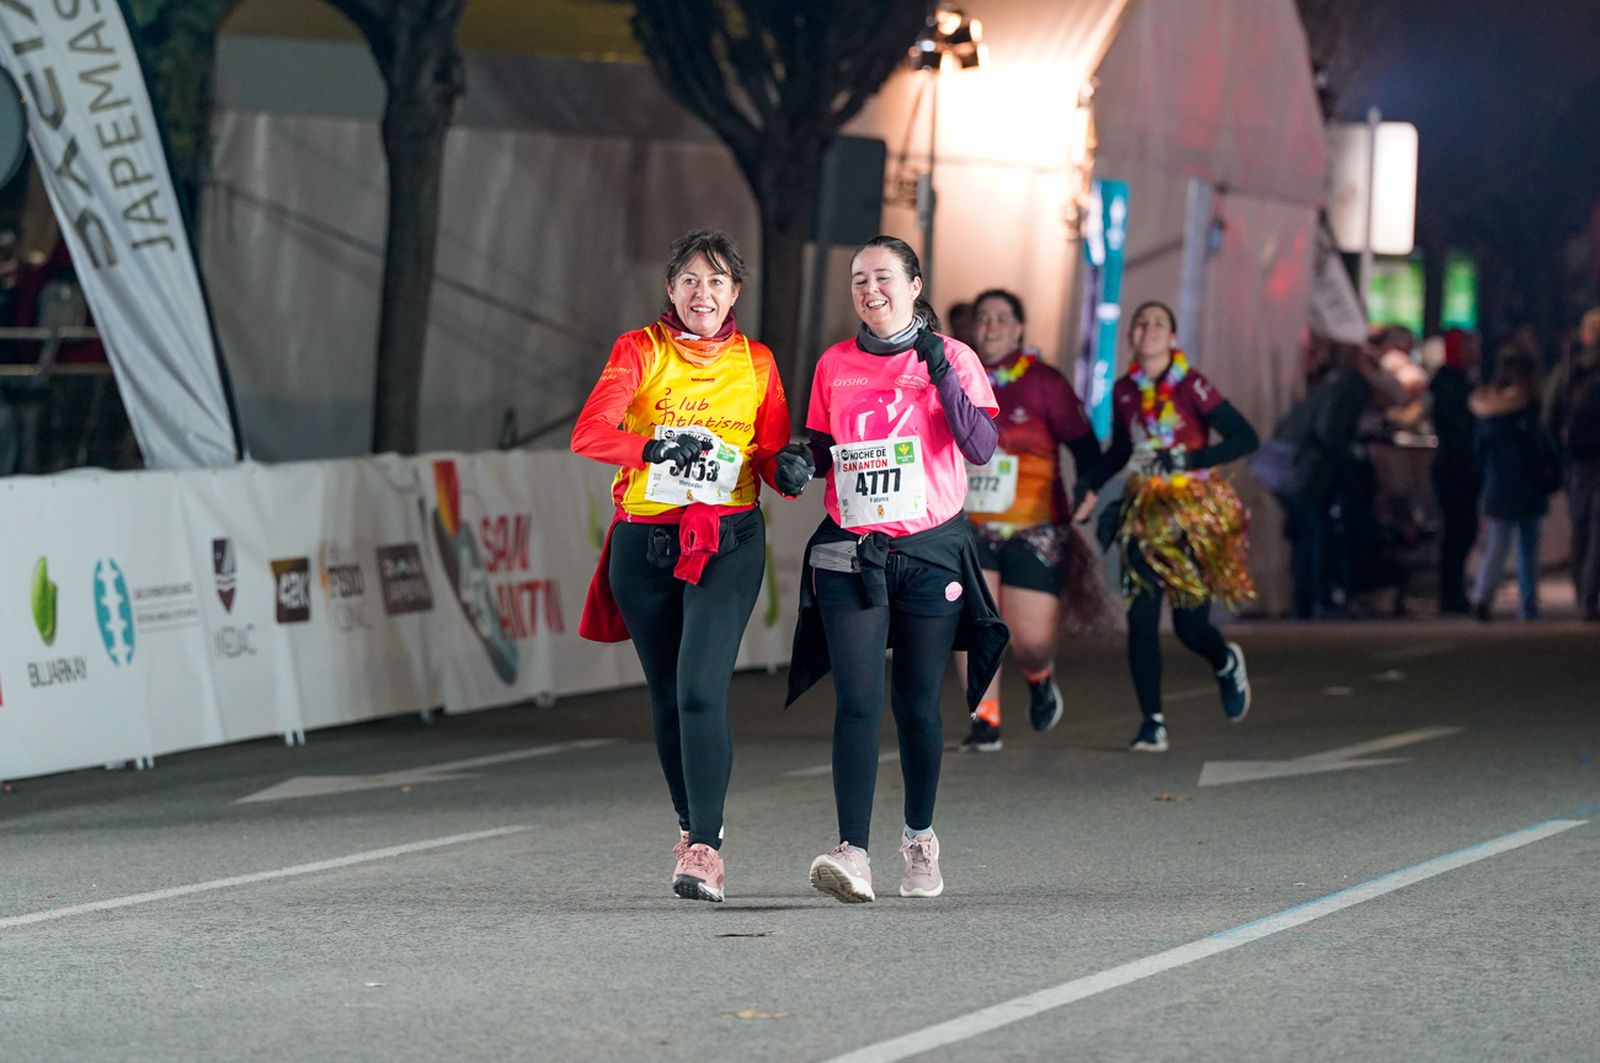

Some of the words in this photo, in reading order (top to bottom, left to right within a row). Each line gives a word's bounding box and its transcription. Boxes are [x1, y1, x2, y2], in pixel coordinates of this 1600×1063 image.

[833, 376, 868, 387] OYSHO
[655, 396, 710, 411] Club
[658, 411, 752, 432] Atletismo
[850, 450, 875, 460] NOCHE
[876, 449, 887, 457] DE
[843, 462, 858, 473] SAN
[855, 468, 901, 497] 4777
